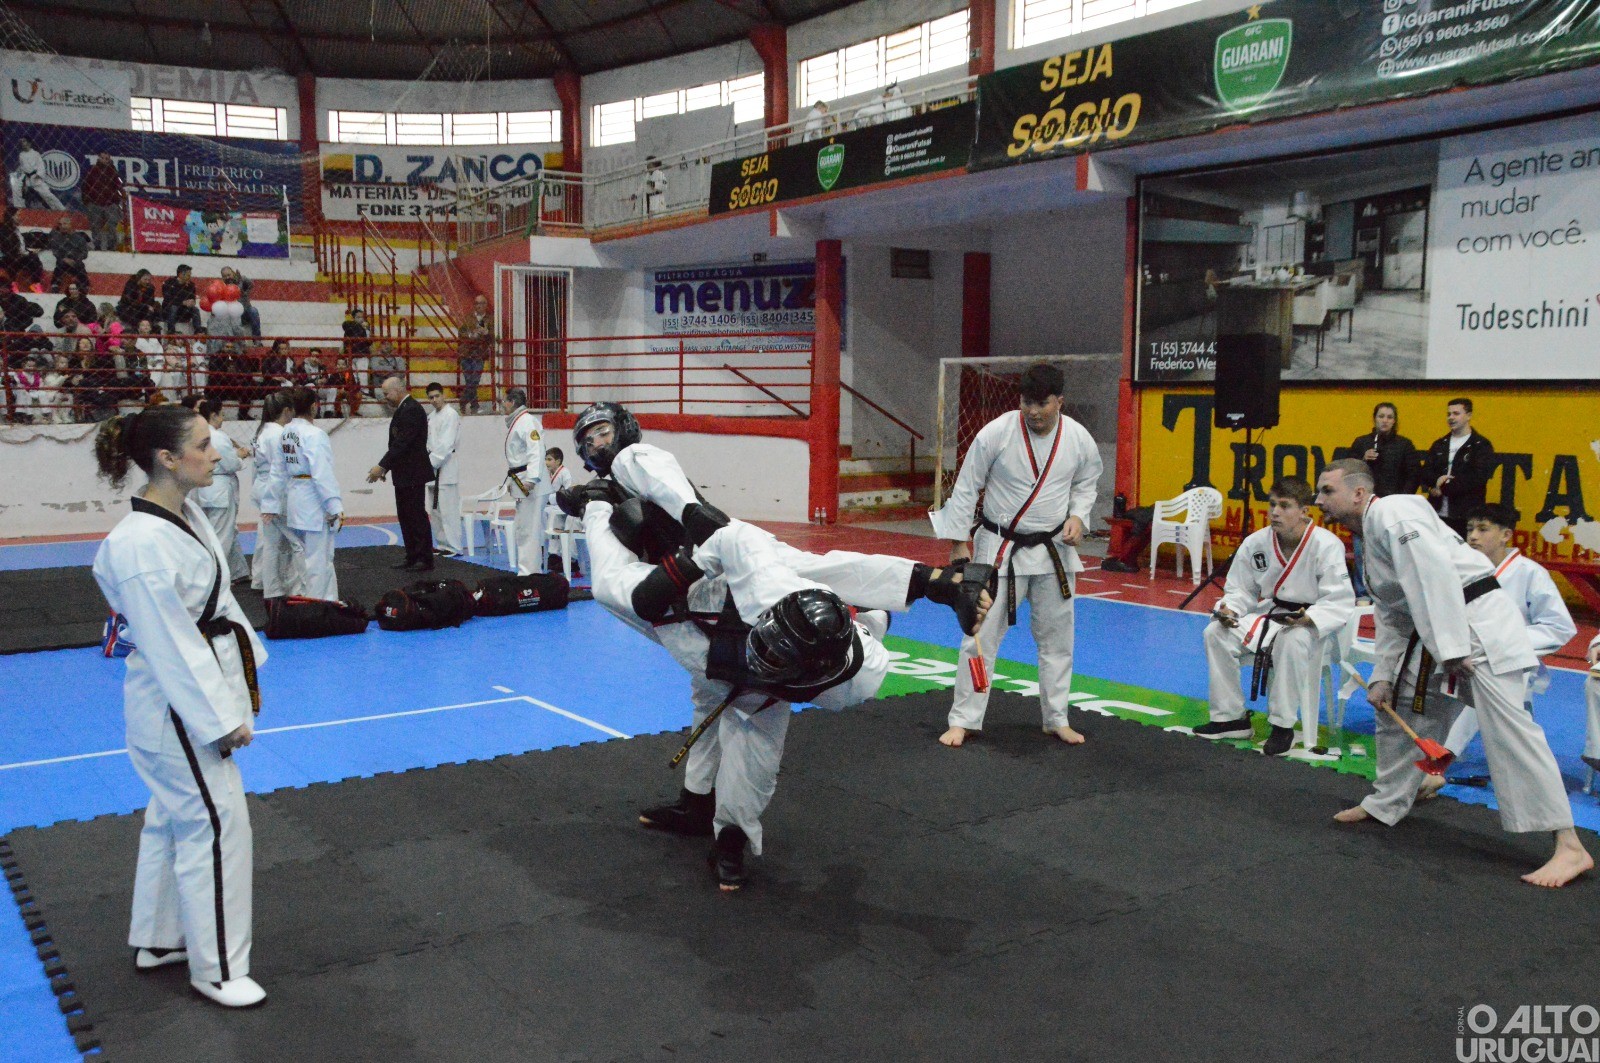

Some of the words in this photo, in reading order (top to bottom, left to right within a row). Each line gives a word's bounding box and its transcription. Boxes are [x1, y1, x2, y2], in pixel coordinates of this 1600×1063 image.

[1222, 36, 1285, 70] GUARANI
[1425, 31, 1434, 44] 9
[1040, 44, 1114, 92] SEJA
[1007, 92, 1142, 158] SÓCIO
[355, 153, 392, 184] D.
[406, 152, 543, 185] ZANCO
[741, 154, 769, 177] SEJA
[1464, 157, 1485, 183] A
[1490, 150, 1563, 187] gente
[1570, 147, 1600, 170] an
[329, 185, 419, 201] MATERIAIS
[729, 177, 779, 210] SÓCIO
[1461, 187, 1540, 219] mudar
[356, 203, 405, 217] FONE
[1456, 233, 1512, 254] com
[1518, 219, 1587, 249] você.
[682, 315, 708, 327] 3744
[710, 313, 737, 326] 1406
[1456, 298, 1590, 331] Todeschini
[1151, 342, 1159, 354] T.
[1161, 341, 1178, 357] (55)
[1180, 341, 1205, 354] 3744
[1151, 357, 1194, 370] Frederico
